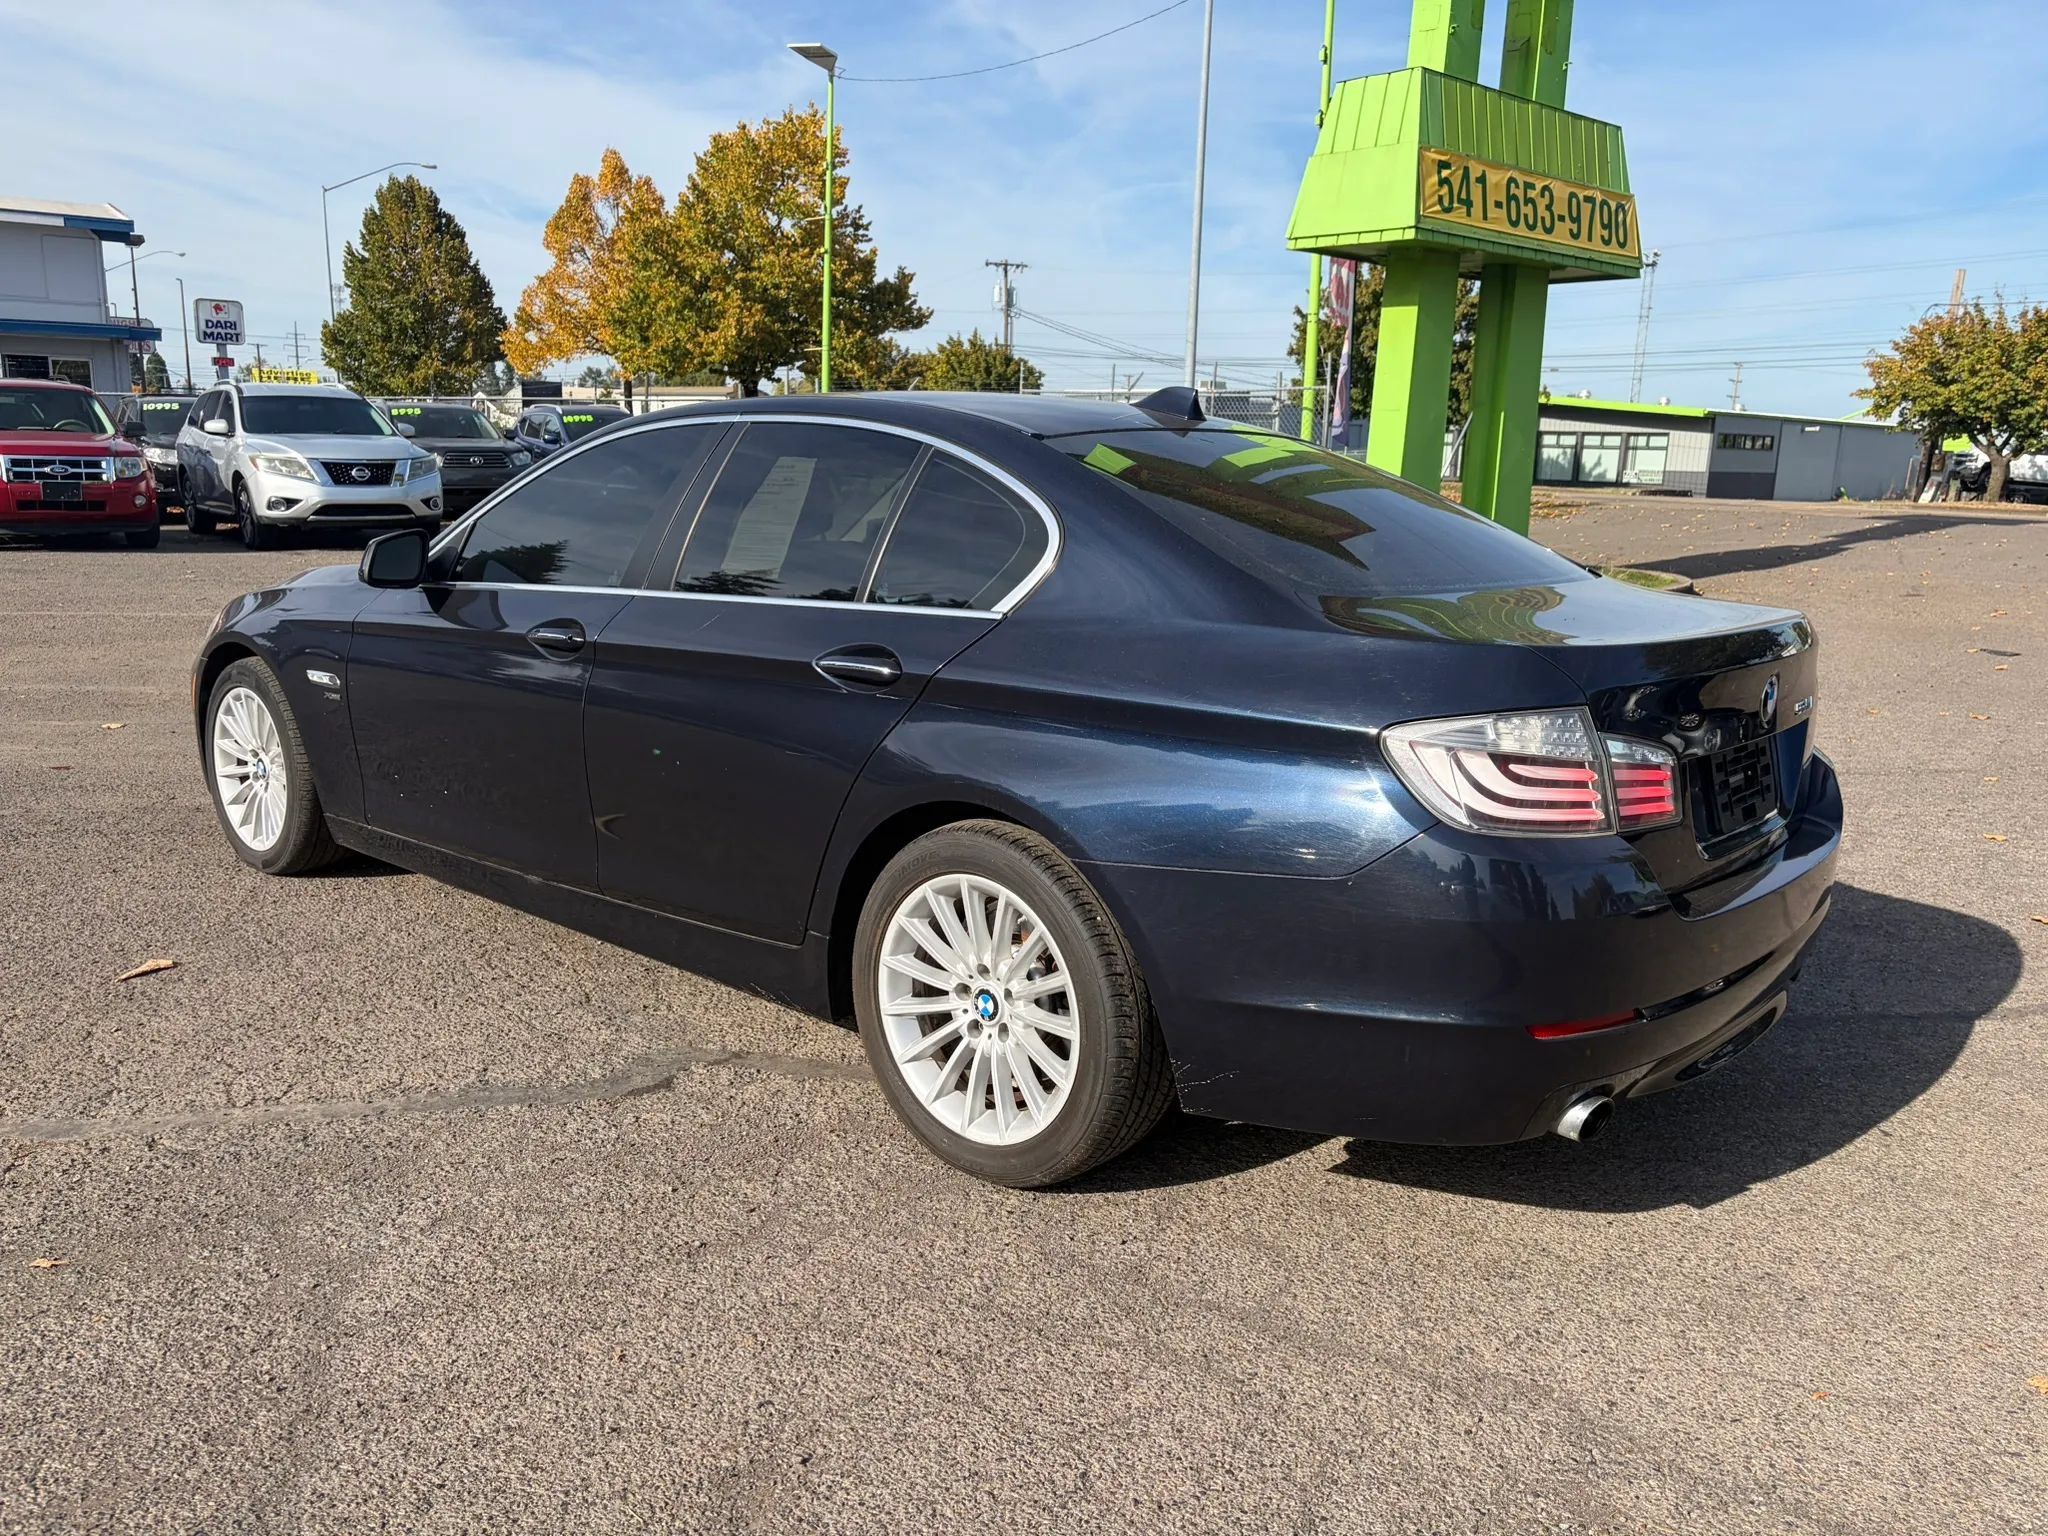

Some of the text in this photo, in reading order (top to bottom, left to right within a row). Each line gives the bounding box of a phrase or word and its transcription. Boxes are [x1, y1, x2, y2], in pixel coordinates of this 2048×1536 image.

[1437, 160, 1628, 249] 541-653-9790
[204, 319, 238, 331] DARI
[203, 330, 241, 343] MART
[143, 402, 180, 411] 10995
